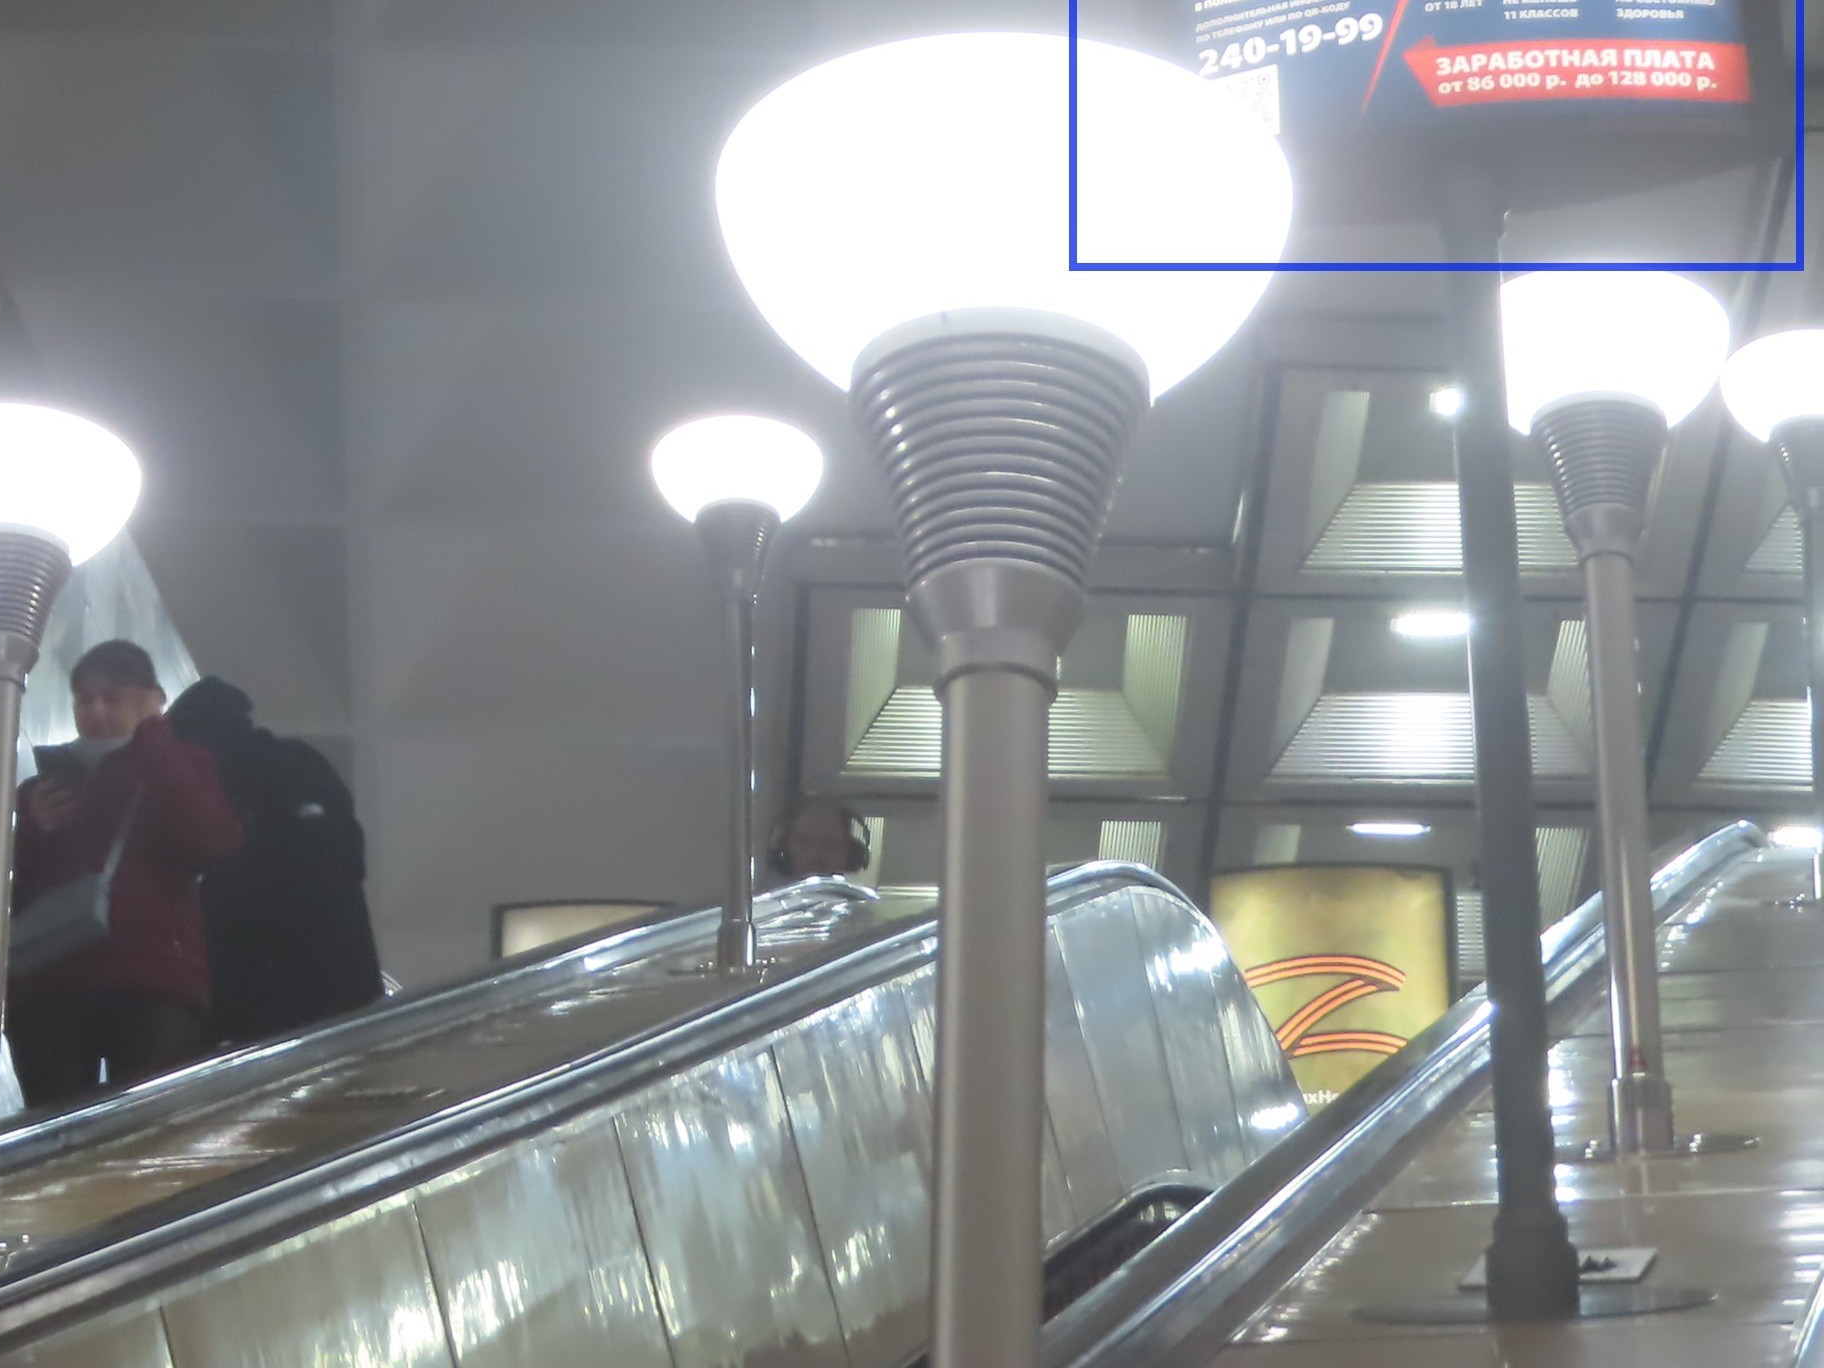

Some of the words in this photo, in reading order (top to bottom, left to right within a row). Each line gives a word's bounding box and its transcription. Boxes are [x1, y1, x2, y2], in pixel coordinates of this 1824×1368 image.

[1195, 3, 1202, 12] В
[1196, 1, 1288, 32] ДОПОЛНИТЕЛЬНАЯ
[1425, 2, 1440, 12] ОТ
[1444, 0, 1458, 9] 18
[1504, 10, 1517, 20] 11
[1519, 8, 1578, 19] КЛАССОВ
[1616, 8, 1684, 19] ЗДОРОВЬЯ
[1196, 34, 1210, 43] ПО
[1212, 21, 1263, 39] ТЕЛЕФОНУ
[1265, 15, 1286, 26] ИЛИ
[1288, 10, 1302, 20] ПО
[1199, 13, 1383, 76] 240-19-99
[1436, 51, 1618, 76] ЗАРАБОТНАЯ
[1623, 49, 1715, 70] ПЛАТА
[1437, 82, 1463, 94] от
[1467, 75, 1495, 92] 86
[1499, 72, 1540, 88] 000
[1545, 74, 1567, 91] р.
[1575, 74, 1604, 88] до
[1608, 71, 1646, 86] 128
[1651, 72, 1691, 87] 000
[1696, 76, 1717, 91] р.
